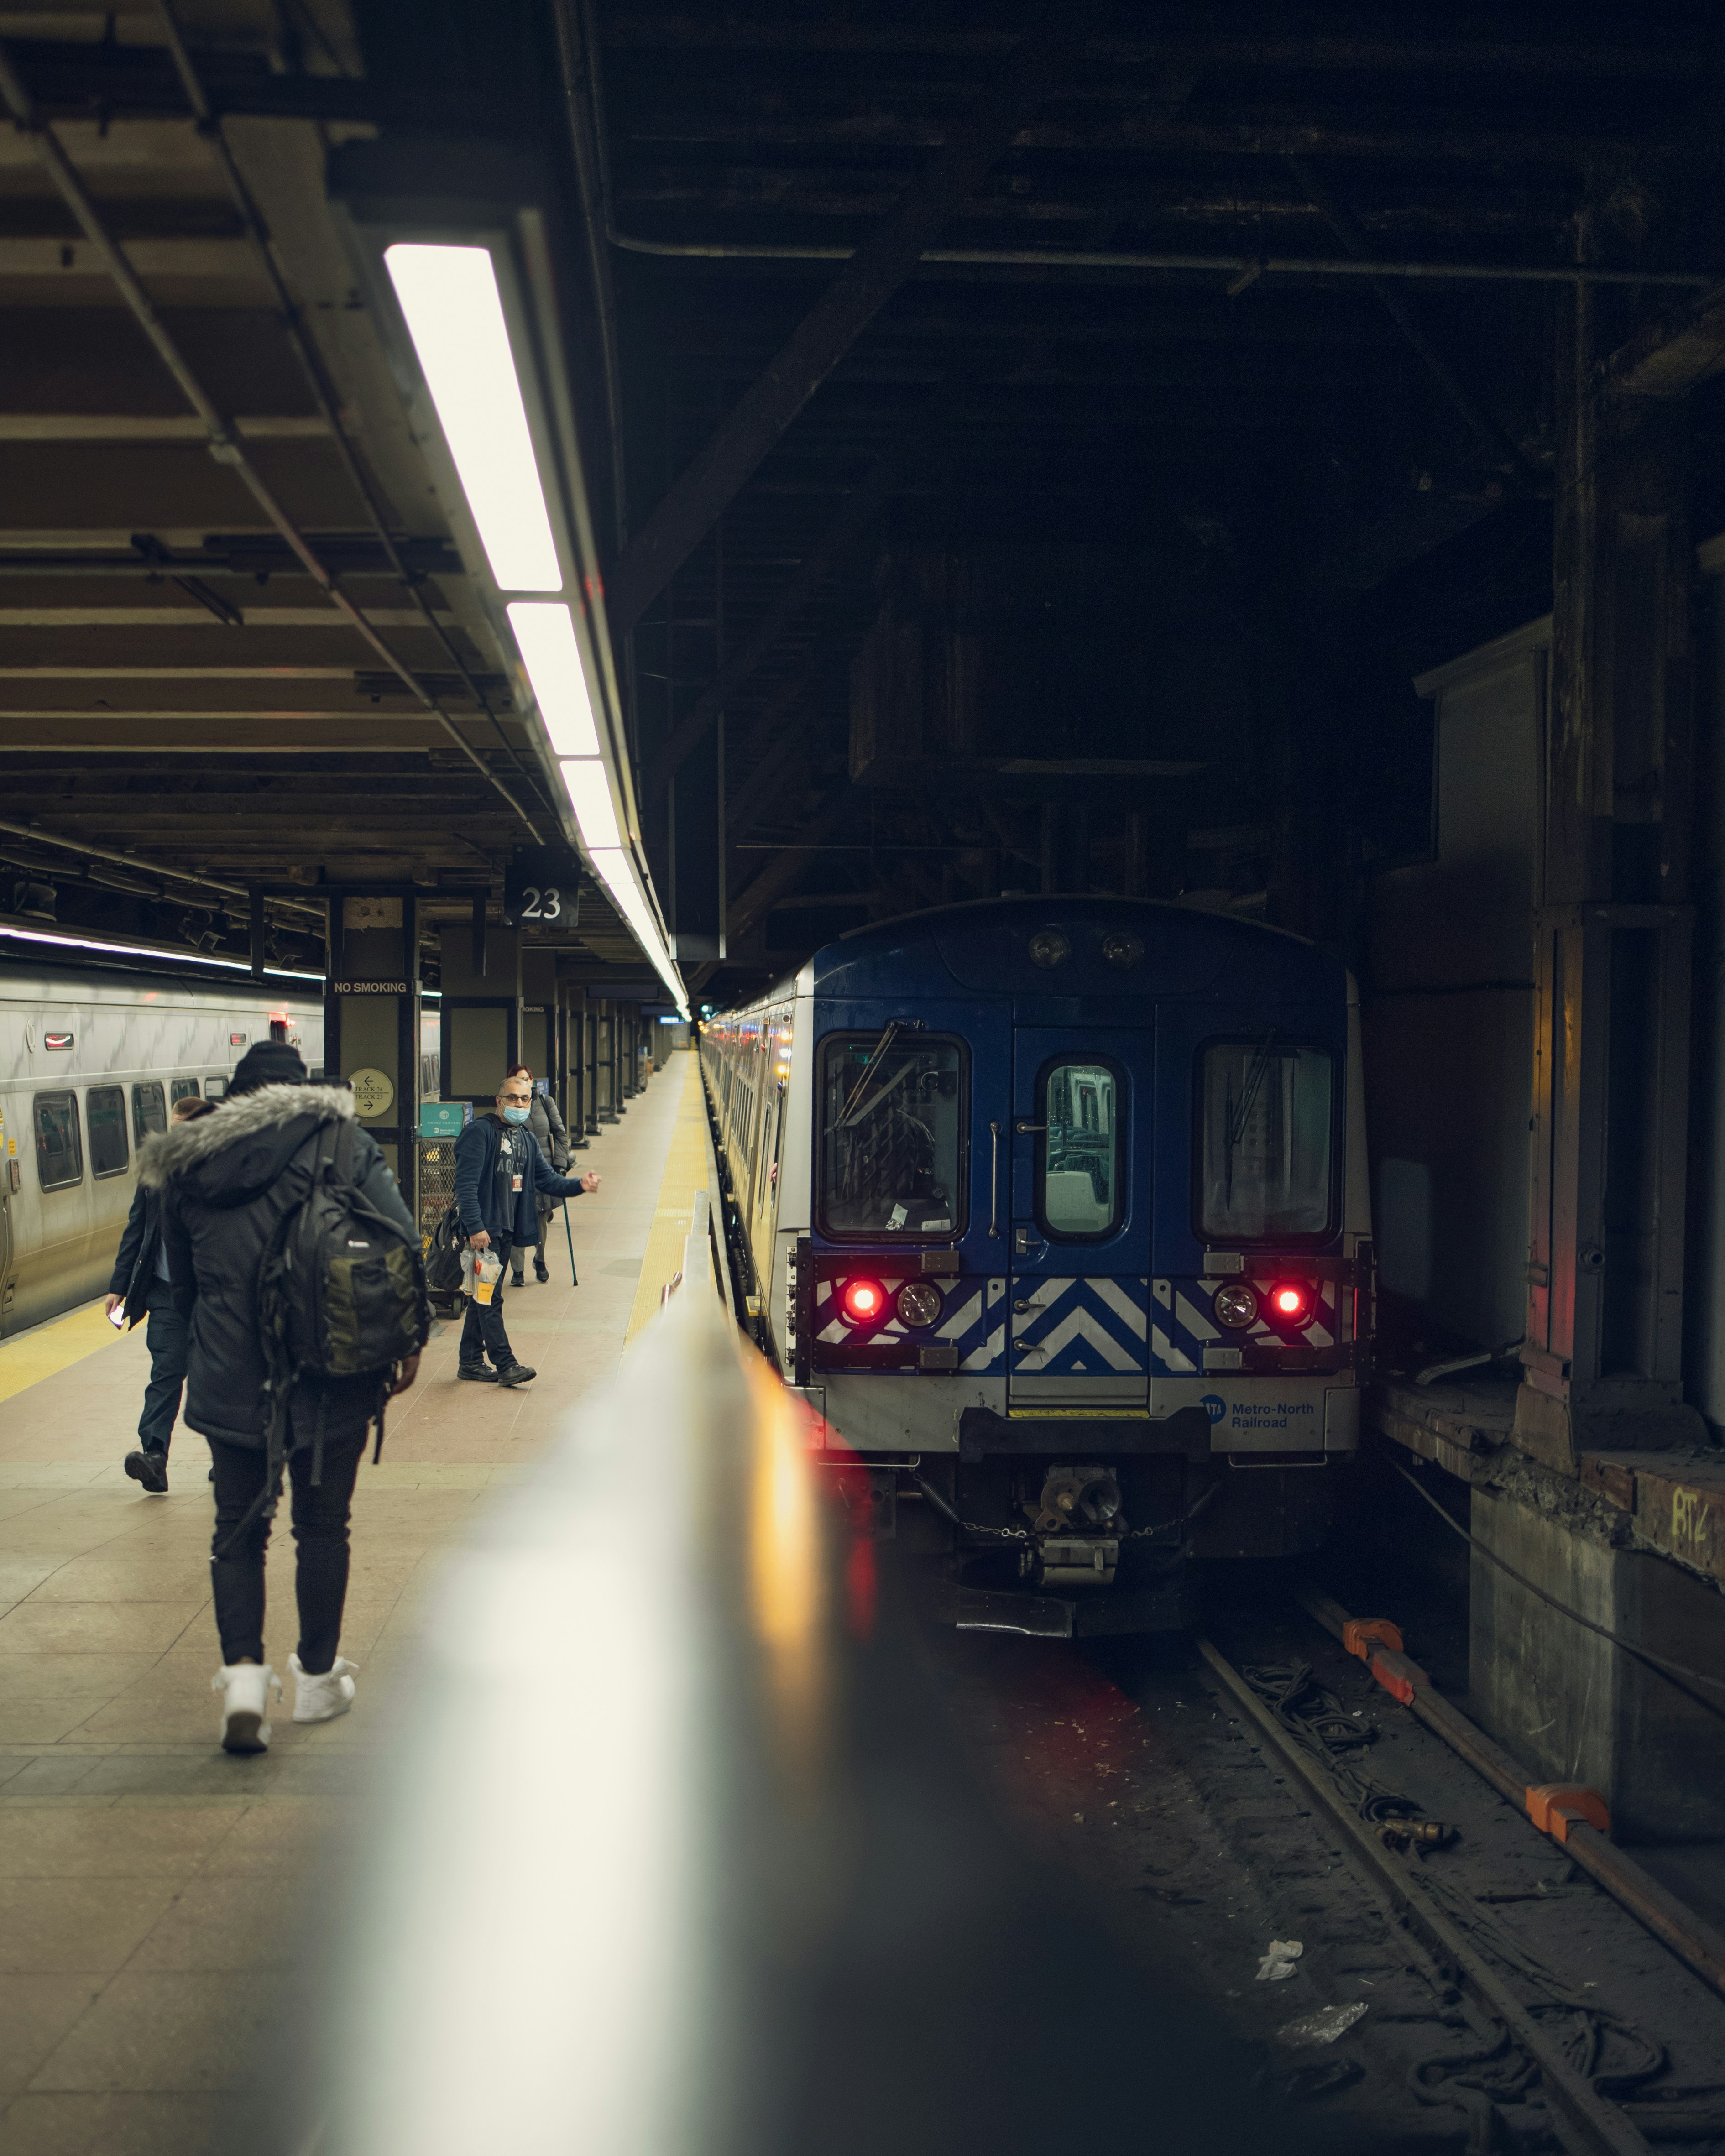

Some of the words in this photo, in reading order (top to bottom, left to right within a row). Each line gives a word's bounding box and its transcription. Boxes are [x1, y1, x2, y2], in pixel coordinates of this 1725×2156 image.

[522, 887, 560, 919] 23
[335, 982, 351, 992] NO
[354, 982, 406, 992] SMOKING
[1232, 1403, 1314, 1415] Metro-North
[1232, 1417, 1287, 1428] Railroad
